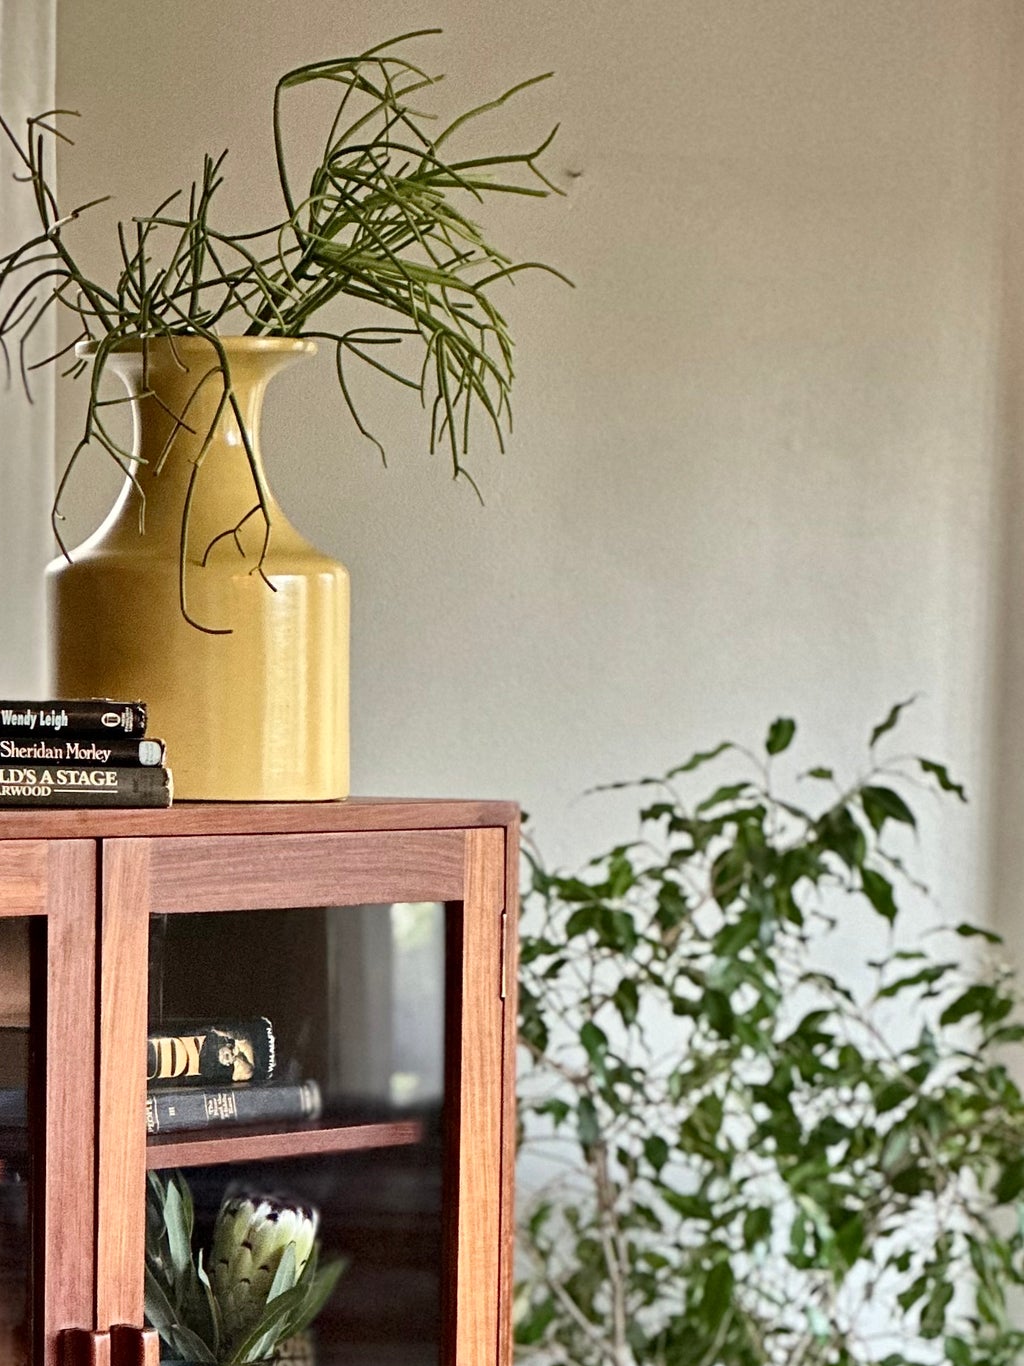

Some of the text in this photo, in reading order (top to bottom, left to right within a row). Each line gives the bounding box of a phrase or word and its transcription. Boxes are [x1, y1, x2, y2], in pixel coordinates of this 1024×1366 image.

[1, 709, 37, 730] Wendy
[40, 709, 68, 731] Leigh
[0, 740, 63, 760] Sheridan
[66, 742, 112, 763] Morley
[40, 770, 55, 785] A
[57, 770, 118, 786] STAGE
